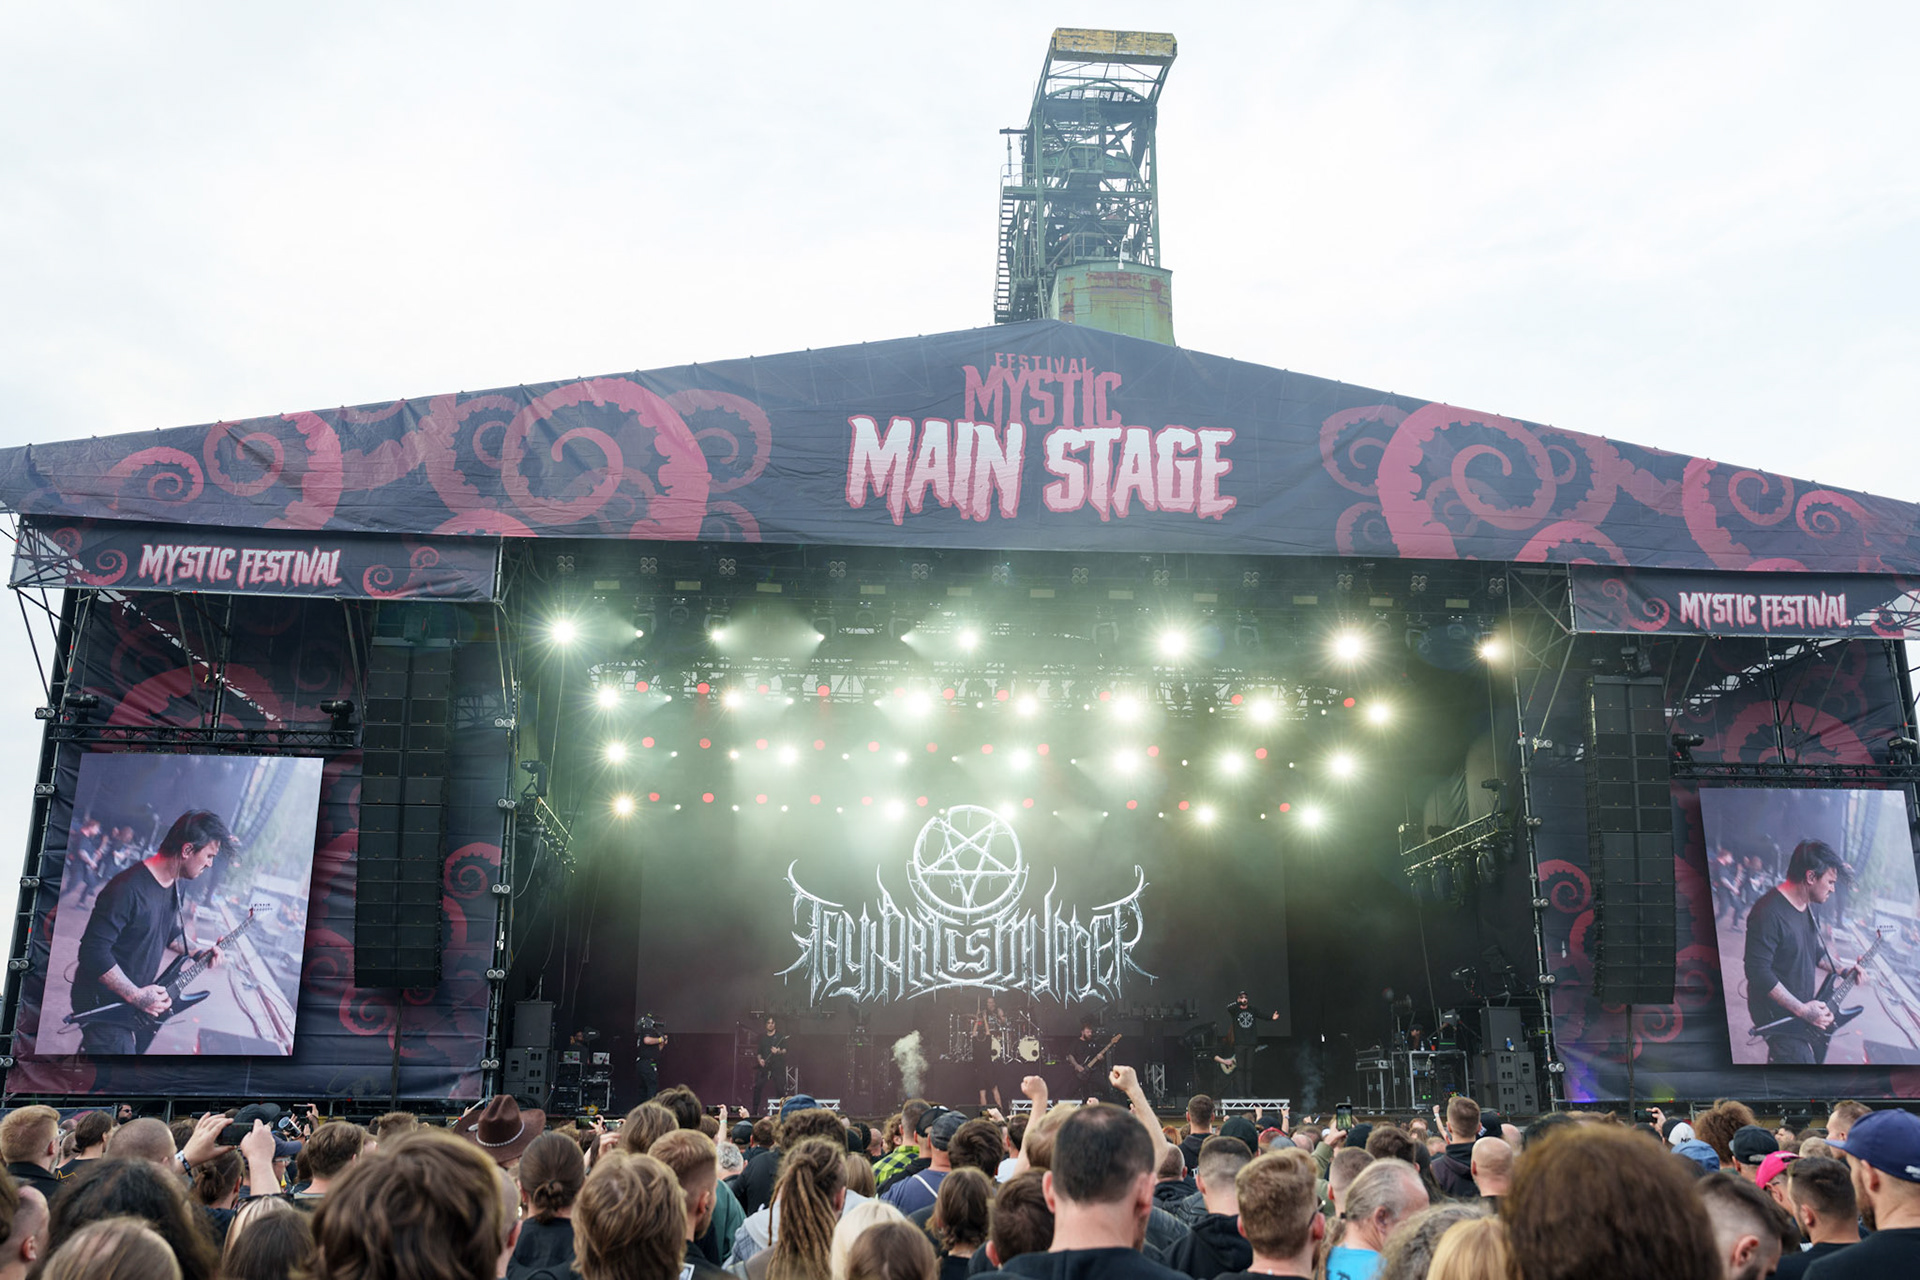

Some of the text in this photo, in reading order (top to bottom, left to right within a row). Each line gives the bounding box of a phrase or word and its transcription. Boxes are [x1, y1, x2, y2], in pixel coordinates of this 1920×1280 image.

[995, 352, 1095, 375] FESTIVAL
[962, 365, 1123, 428] MYSTIC
[846, 415, 1237, 526] MAIN STAGE
[138, 544, 342, 590] MYSTIC FESTIVAL
[1679, 591, 1848, 632] MYSTIC FESTIVAL
